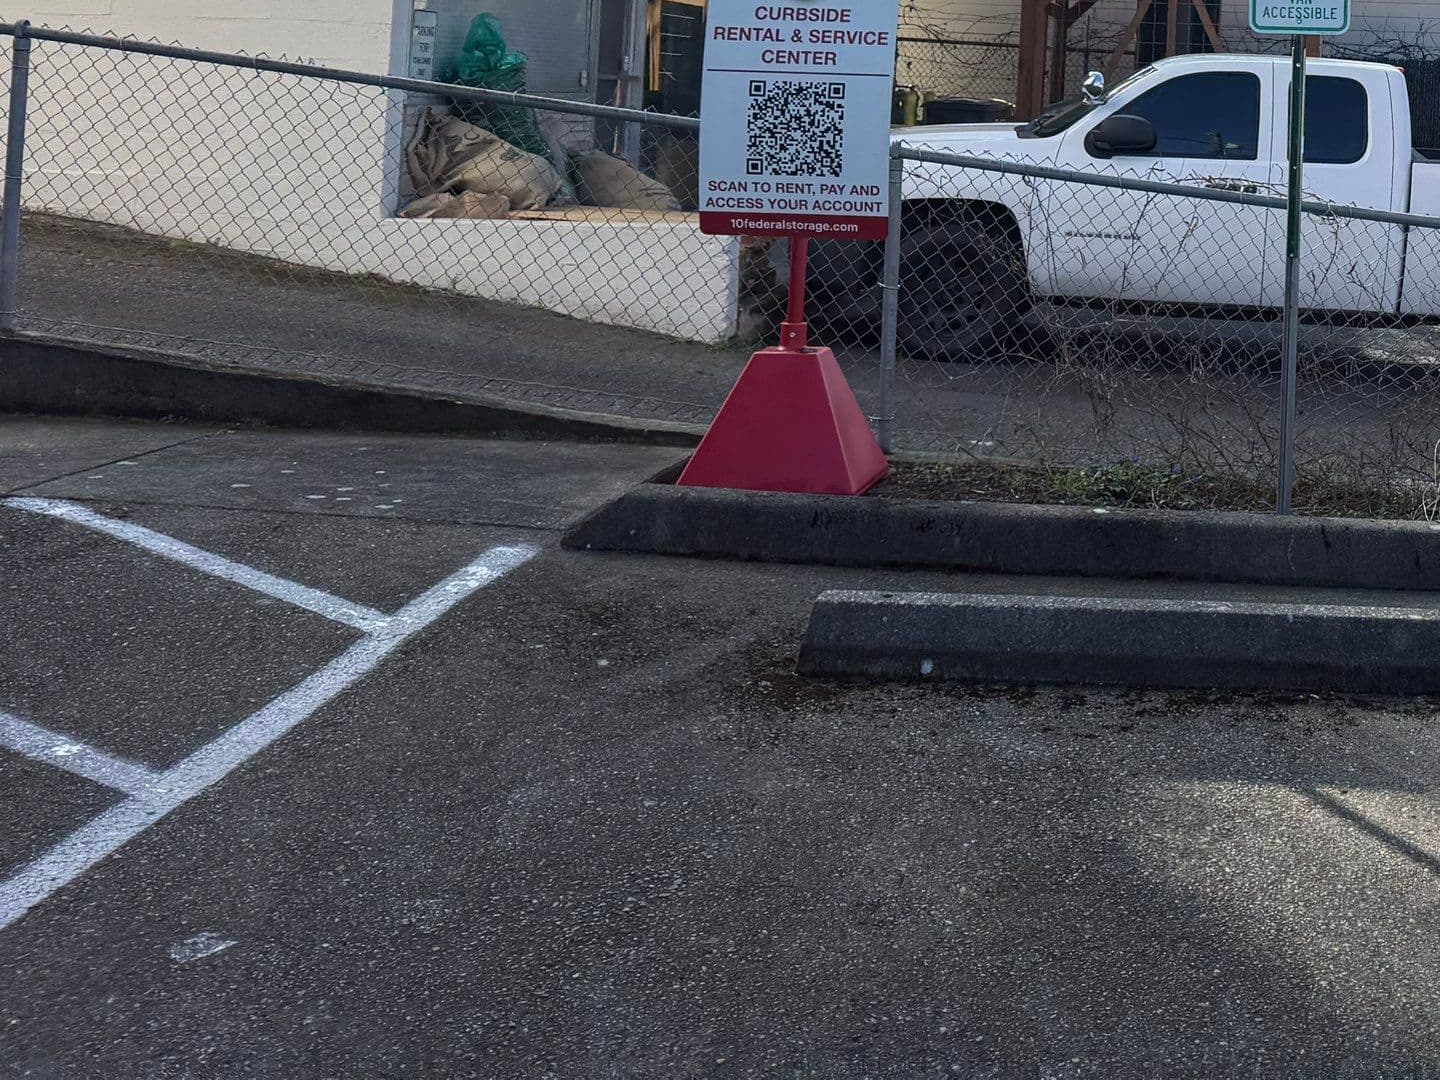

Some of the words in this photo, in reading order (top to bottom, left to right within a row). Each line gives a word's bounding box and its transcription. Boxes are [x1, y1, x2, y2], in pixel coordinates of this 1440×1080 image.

[754, 5, 852, 23] CURBSIDE
[1262, 6, 1338, 20] ACCESSIBLE
[713, 26, 786, 43] RENTAL
[790, 29, 803, 44] &
[808, 29, 889, 46] SERVICE
[761, 49, 837, 66] CENTER
[708, 180, 748, 193] SCAN
[752, 182, 771, 193] TO
[775, 183, 816, 197] RENT,
[820, 184, 846, 195] PAY
[850, 184, 880, 197] AND
[705, 197, 764, 209] ACCESS
[767, 198, 808, 211] YOUR
[812, 200, 883, 213] ACCOUNT
[730, 218, 859, 233] 10federalstorage.com
